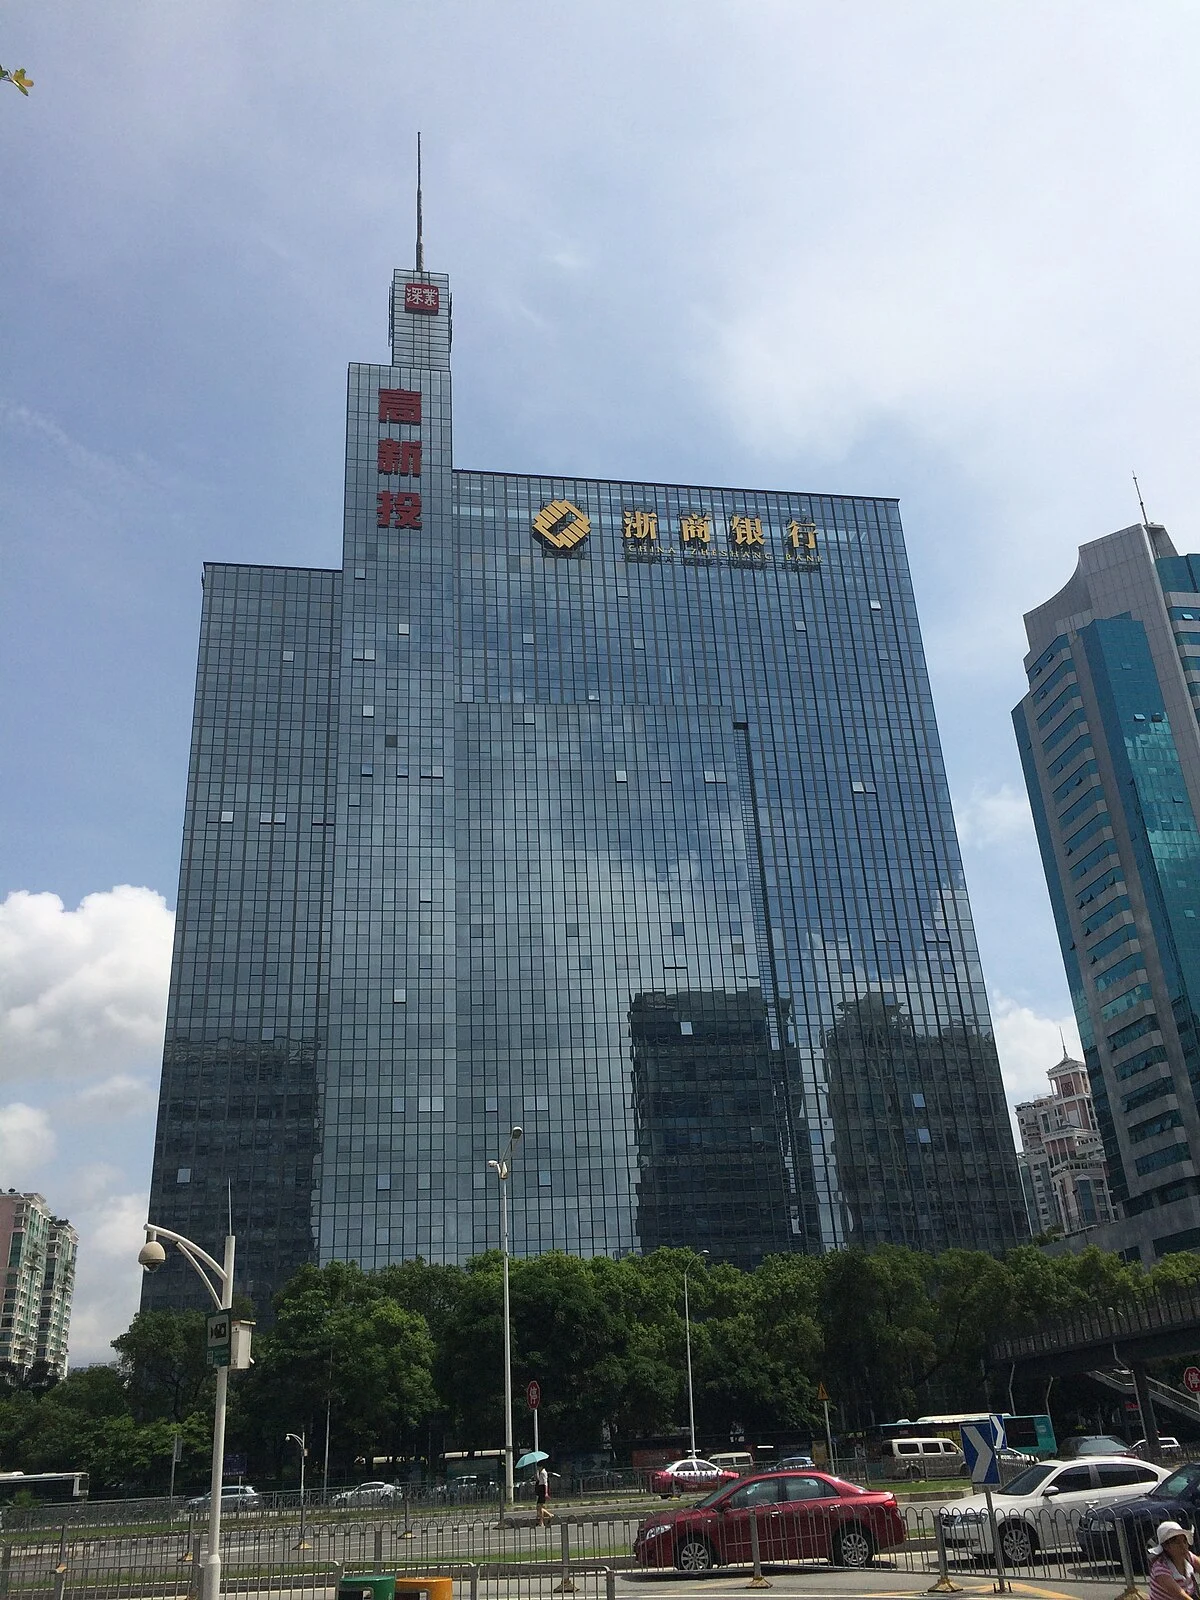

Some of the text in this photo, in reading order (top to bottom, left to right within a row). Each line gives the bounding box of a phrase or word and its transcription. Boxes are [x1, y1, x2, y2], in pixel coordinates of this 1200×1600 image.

[406, 286, 438, 307] 深業
[377, 388, 422, 529] 高新投
[623, 511, 819, 548] 浙商银行
[628, 544, 823, 563] CHINA ZHESHANG BANK
[529, 1386, 538, 1405] 停
